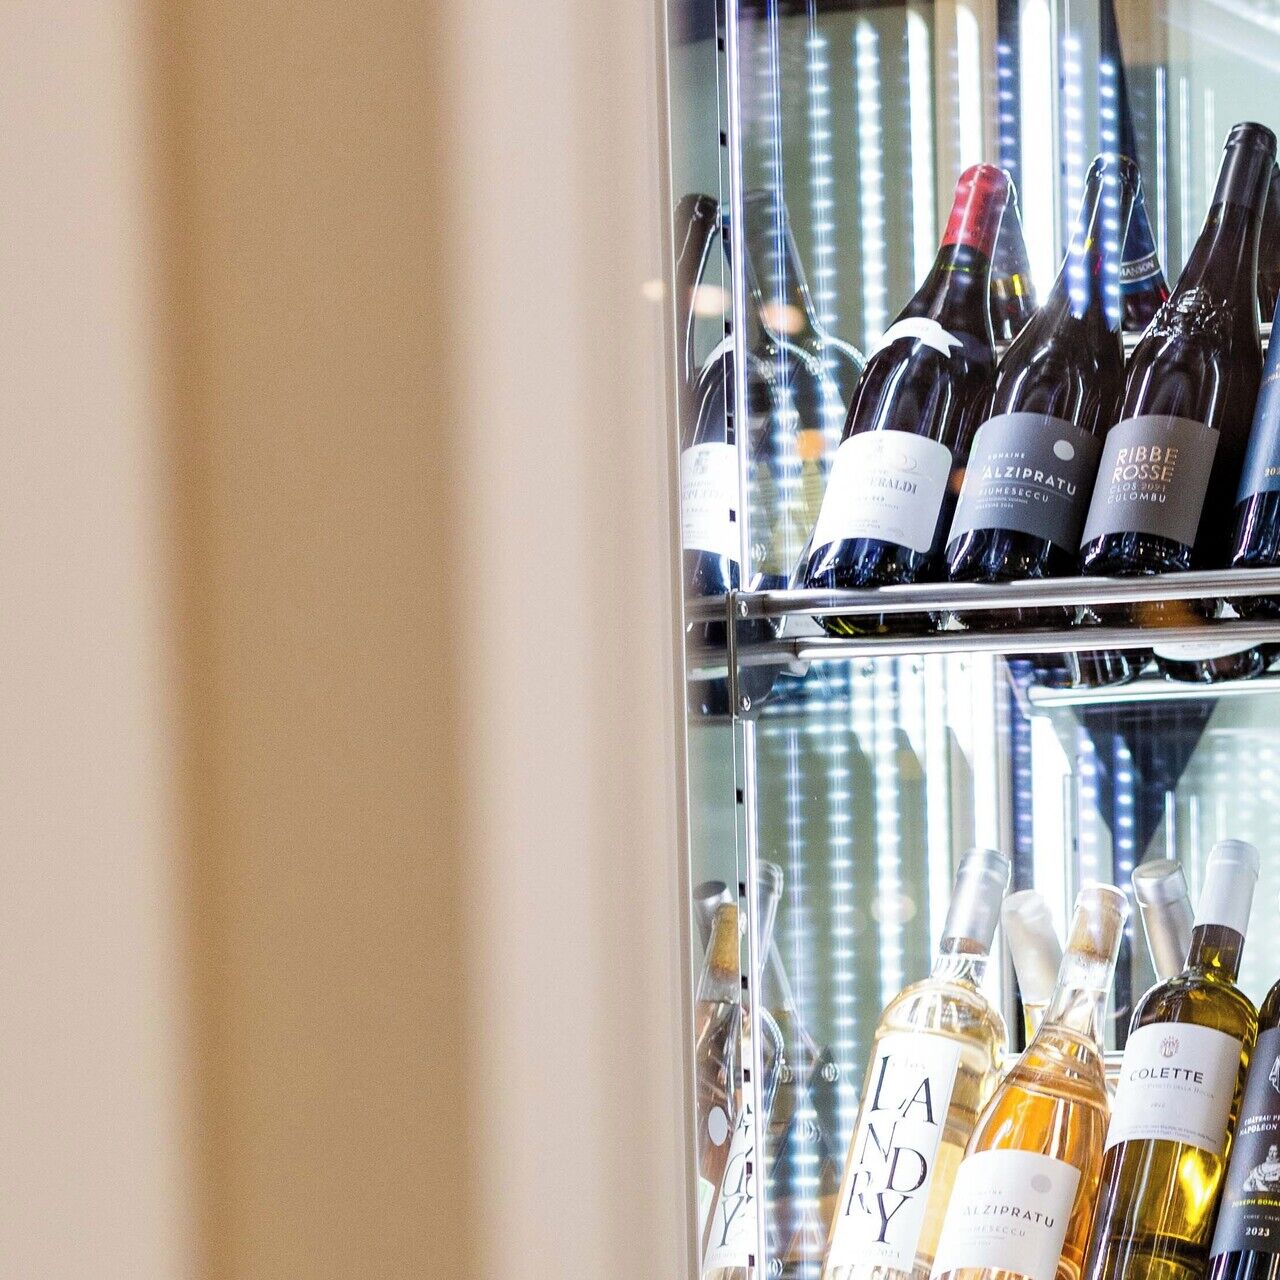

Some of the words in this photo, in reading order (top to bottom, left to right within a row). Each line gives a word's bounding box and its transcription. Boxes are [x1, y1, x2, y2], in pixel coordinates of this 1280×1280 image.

[1116, 446, 1179, 467] RIBBE
[1111, 464, 1175, 484] ROSSE
[1130, 1067, 1205, 1084] COLETTE
[1245, 1226, 1270, 1238] 2023
